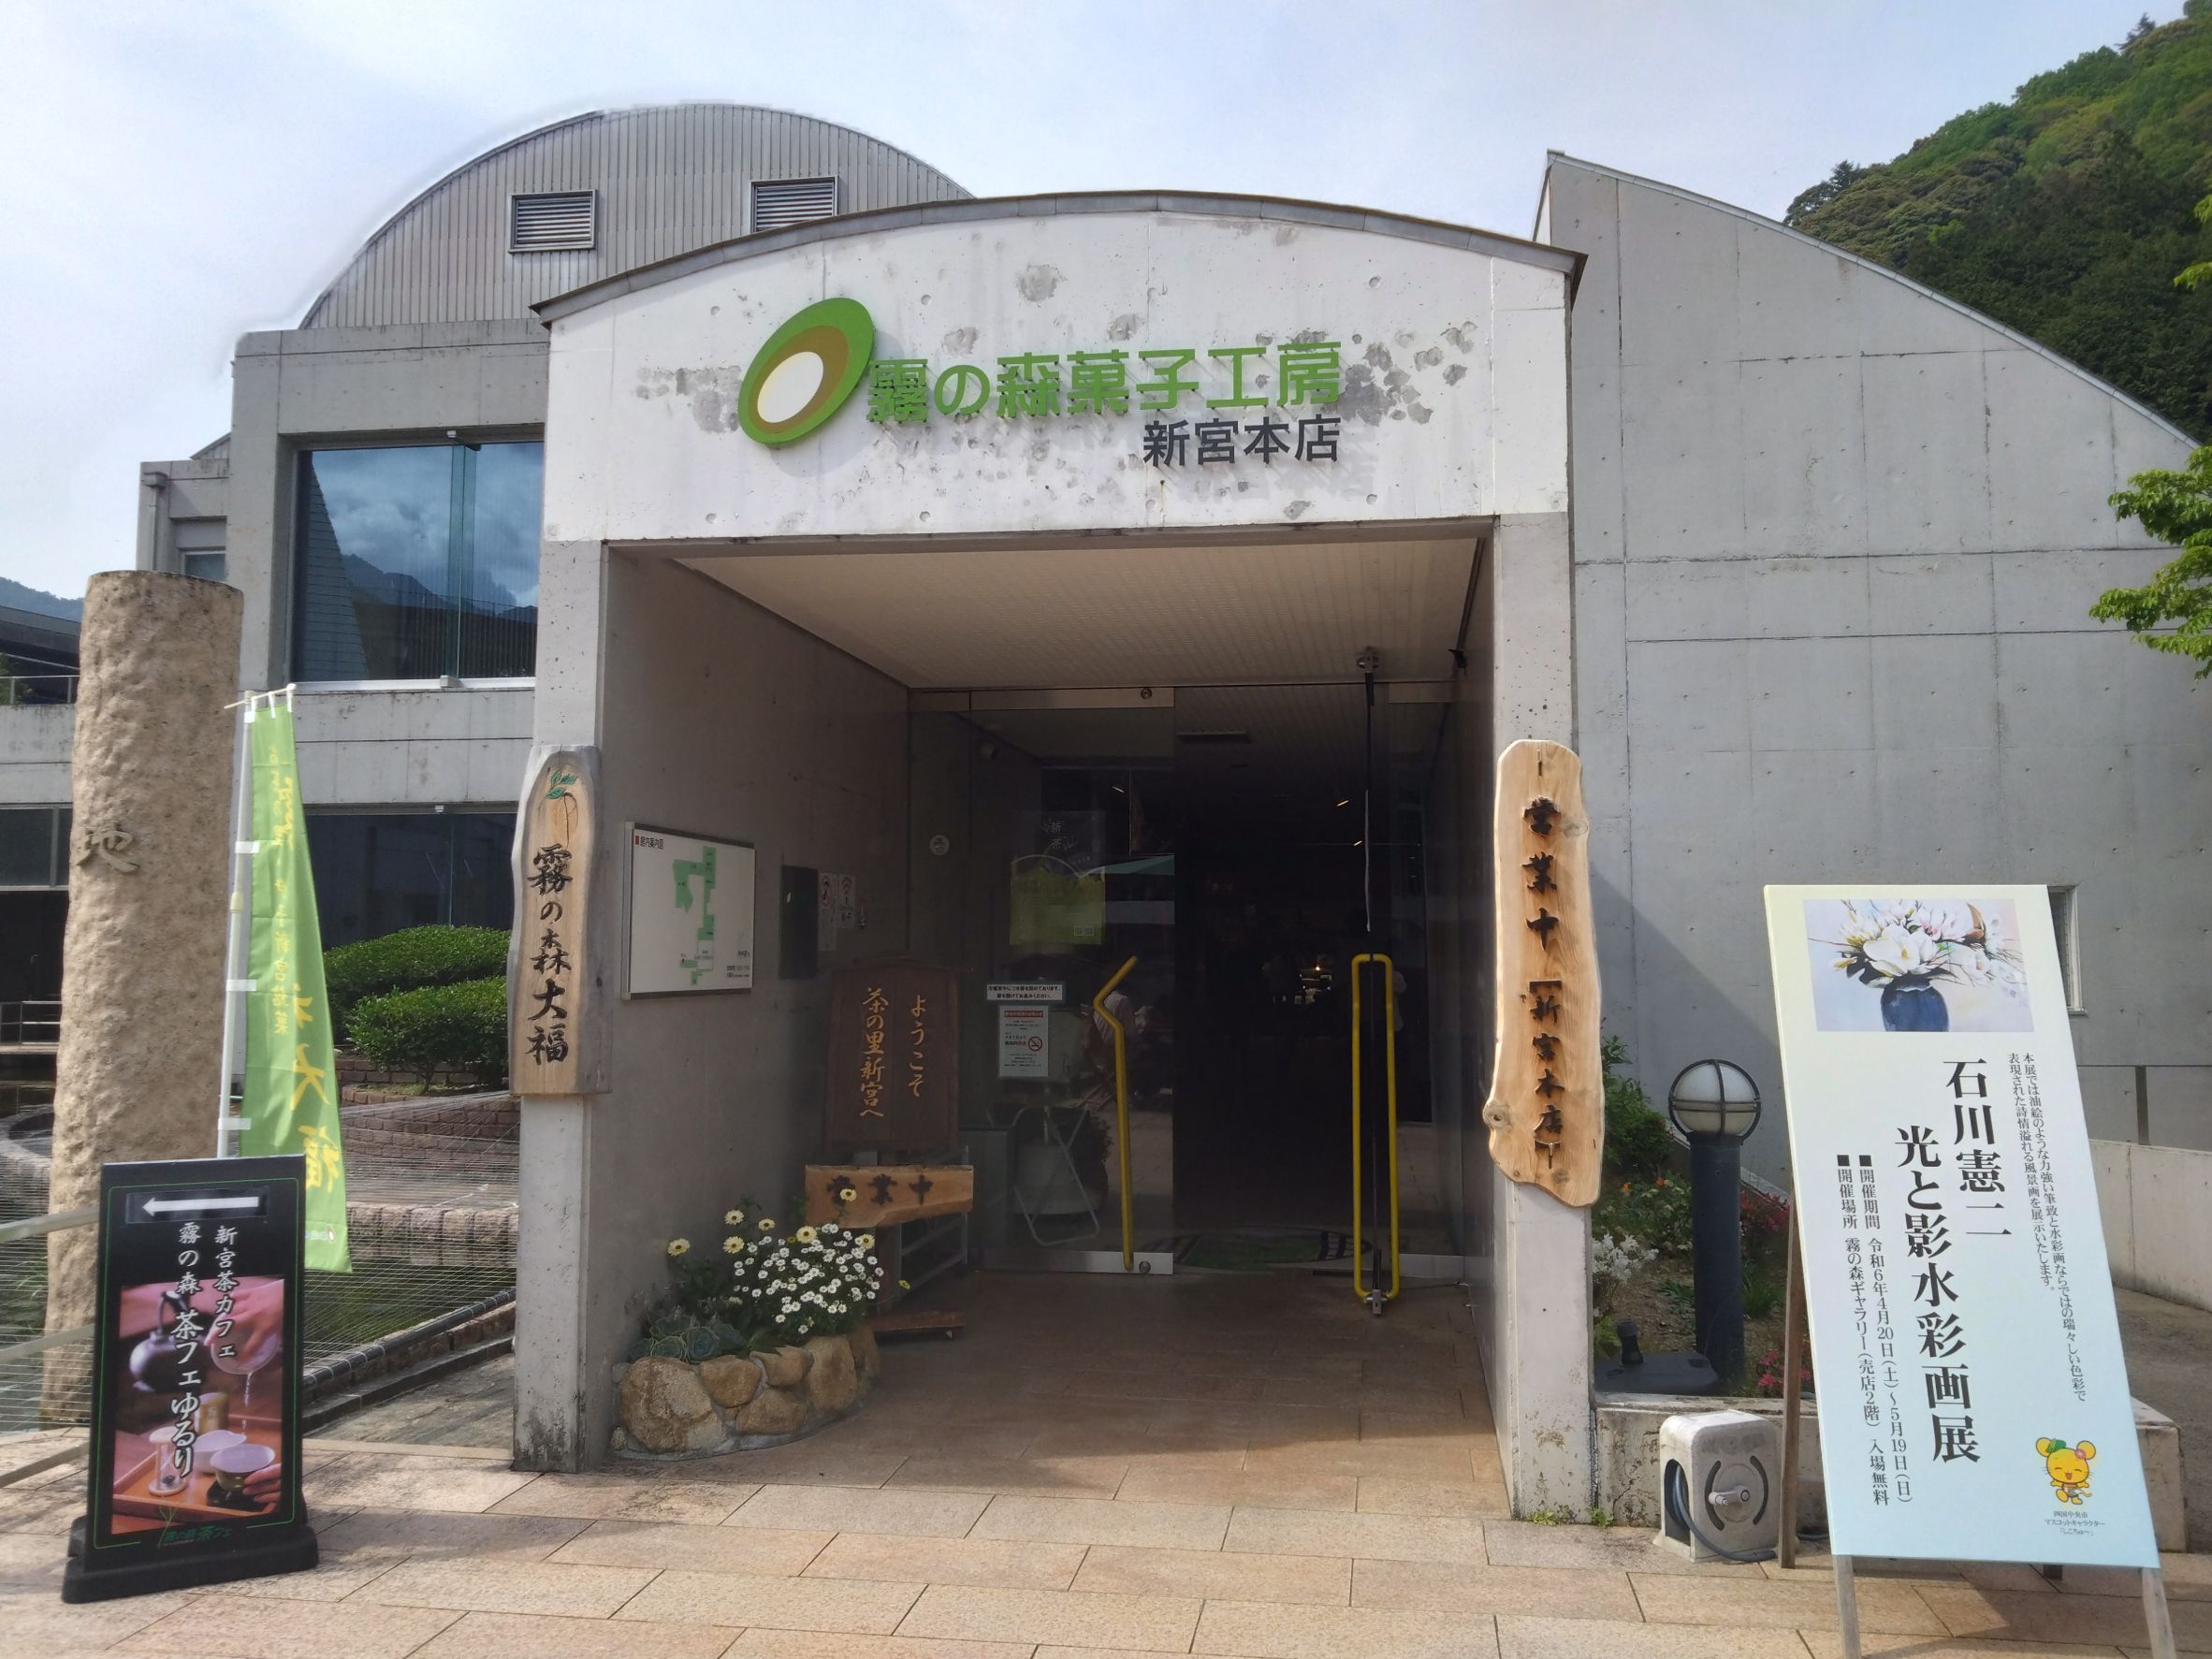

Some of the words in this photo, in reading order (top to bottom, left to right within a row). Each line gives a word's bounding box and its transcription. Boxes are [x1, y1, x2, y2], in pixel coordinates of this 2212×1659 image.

[865, 341, 1342, 425] 霧の森菓子工房
[1142, 414, 1342, 468] 新宮本店
[524, 843, 575, 1066] 霧の森大福
[858, 985, 890, 1118] 茶の里新宮へ
[907, 994, 927, 1098] ようこそ
[1943, 1058, 2012, 1235] 石川憲二
[213, 1224, 239, 1359] 新宮茶カフェ
[1896, 1125, 1981, 1464] 光と影水彩画展
[1869, 1438, 1890, 1506] 入場無料
[2043, 1519, 2106, 1527] マスコットキャラクター
